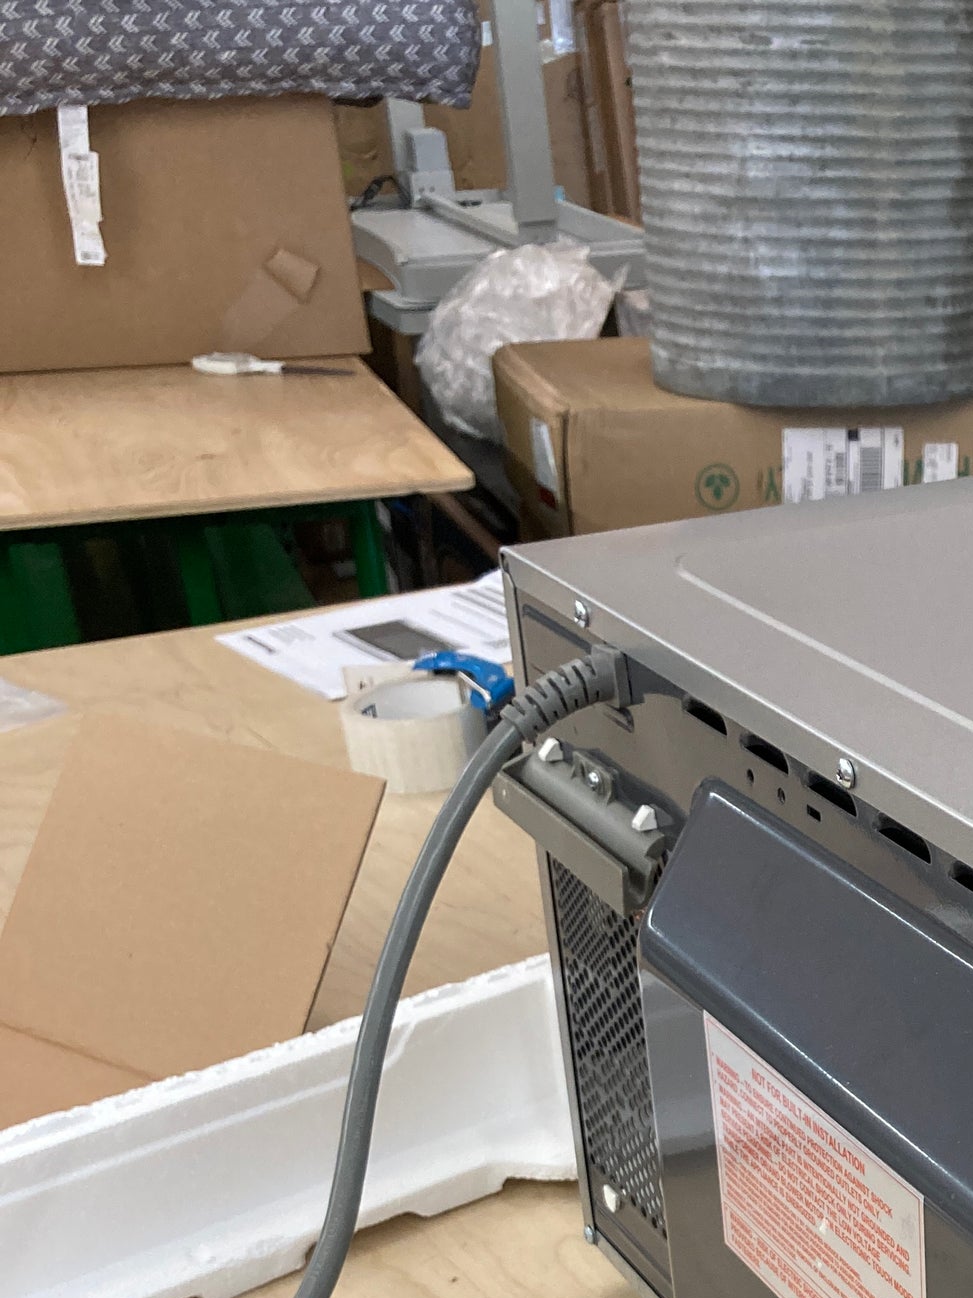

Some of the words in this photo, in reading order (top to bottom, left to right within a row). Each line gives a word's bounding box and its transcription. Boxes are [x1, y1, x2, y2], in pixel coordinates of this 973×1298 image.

[752, 1068, 764, 1089] NOT
[767, 1082, 781, 1102] FOR
[783, 1095, 811, 1129] BUILT-IN
[813, 1121, 864, 1175] INSTALLATION
[804, 1160, 846, 1205] INTENTIONALLY
[848, 1200, 859, 1217] NOT
[862, 1212, 894, 1248] GROUNDED
[897, 1243, 909, 1262] AND
[807, 1135, 842, 1174] PROTECTION
[844, 1168, 869, 1197] AGAINST
[871, 1191, 892, 1218] SHOCK
[816, 1183, 835, 1207] SHOCK
[837, 1202, 851, 1222] ONLY
[853, 1217, 875, 1244] DURING
[836, 1174, 861, 1203] OUTLETS
[800, 1181, 825, 1210] CONTACT
[826, 1205, 837, 1222] THE
[839, 1216, 852, 1235] LOW
[853, 1229, 880, 1261] VOLTAGE
[835, 1225, 871, 1265] ELECTRONIC
[872, 1260, 892, 1285] TOUCH
